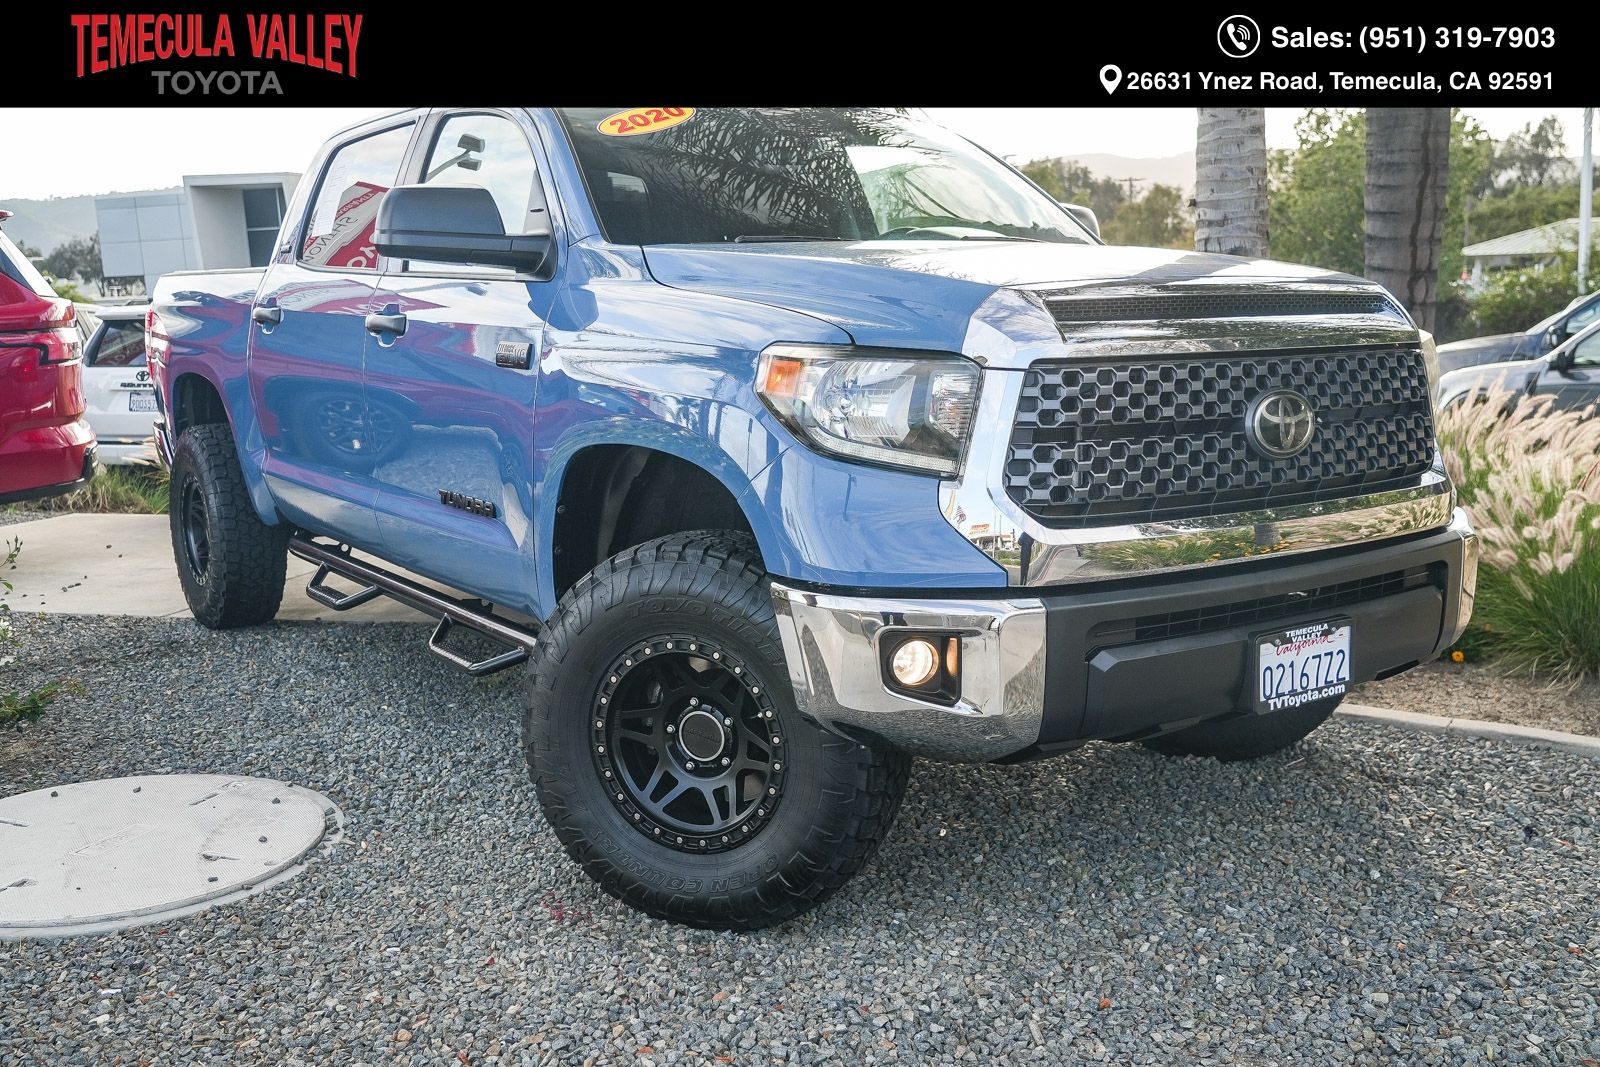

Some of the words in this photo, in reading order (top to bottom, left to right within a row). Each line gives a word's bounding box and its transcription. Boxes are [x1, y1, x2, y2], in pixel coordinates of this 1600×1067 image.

[609, 107, 686, 134] 2020
[438, 488, 497, 518] TUNDRA
[1285, 623, 1329, 638] TEMECULA
[1291, 630, 1323, 643] VALLEY
[1267, 683, 1346, 711] TVToyota.com
